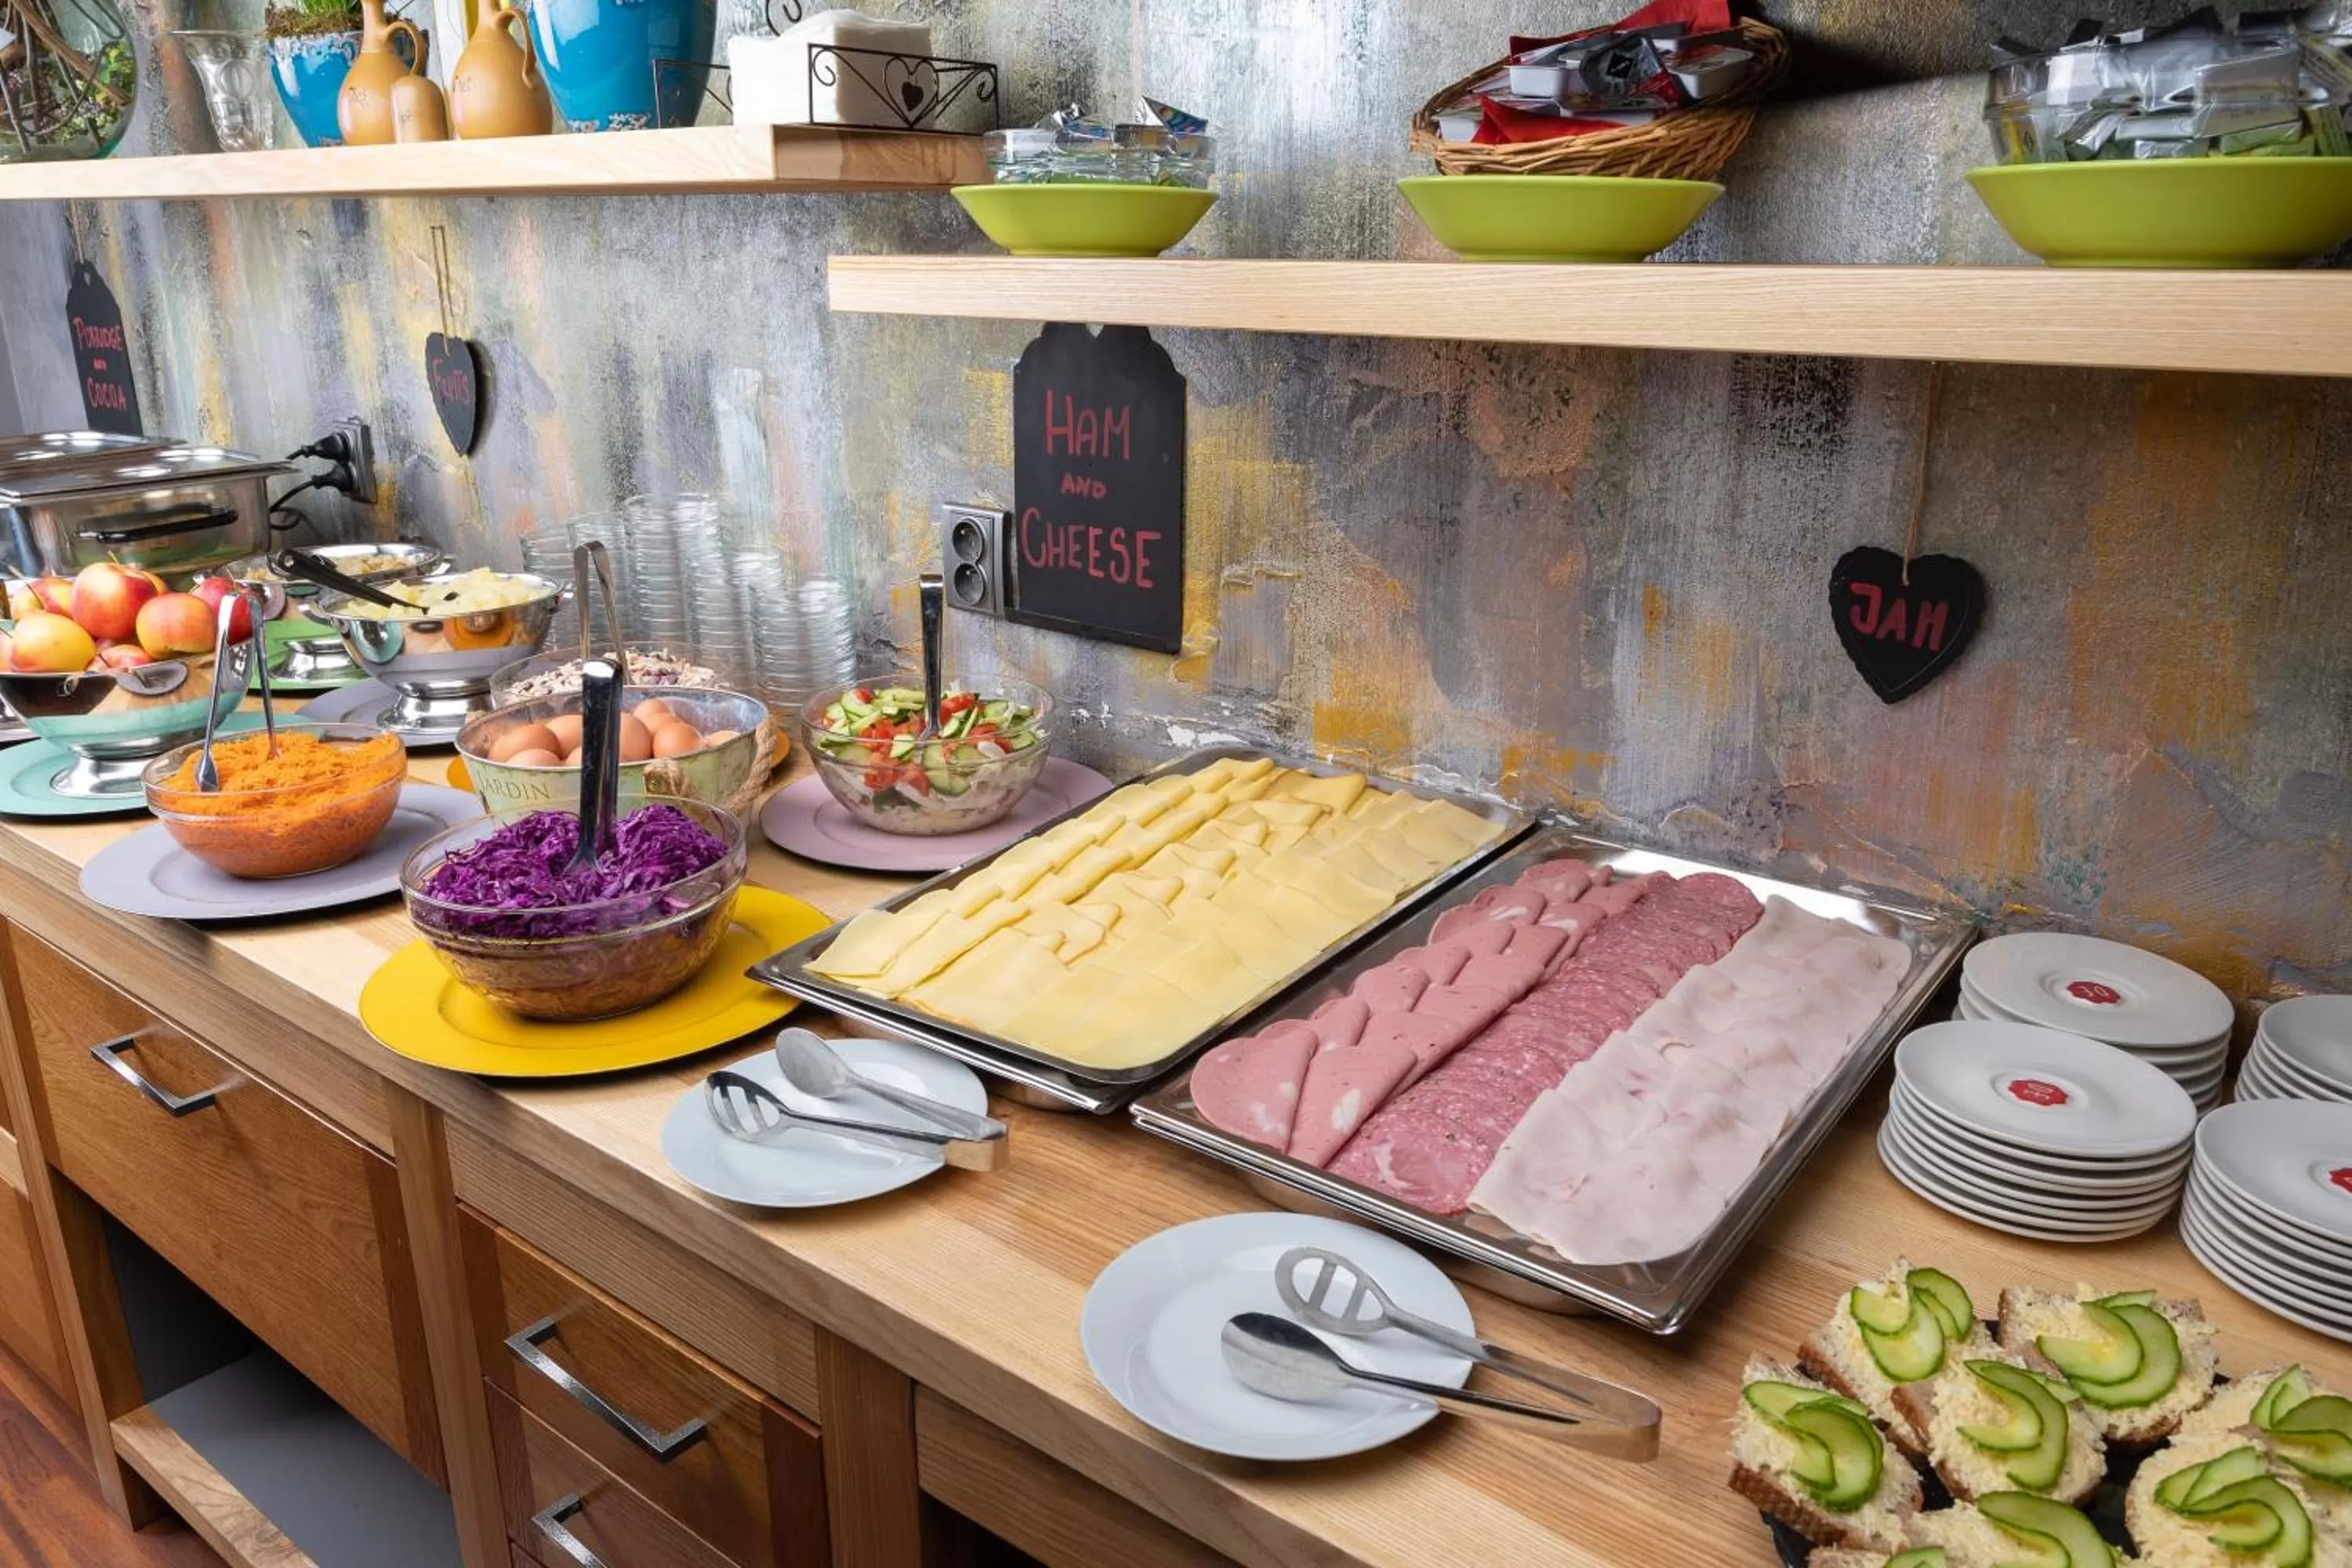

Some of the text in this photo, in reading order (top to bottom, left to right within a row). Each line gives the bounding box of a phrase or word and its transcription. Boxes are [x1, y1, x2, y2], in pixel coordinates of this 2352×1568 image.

[87, 376, 127, 412] COCOA
[1044, 389, 1130, 460] HAM
[1060, 472, 1108, 499] AND
[1021, 506, 1162, 590] CHEESE
[1848, 581, 1950, 652] JAM
[477, 771, 550, 800] JARDIN
